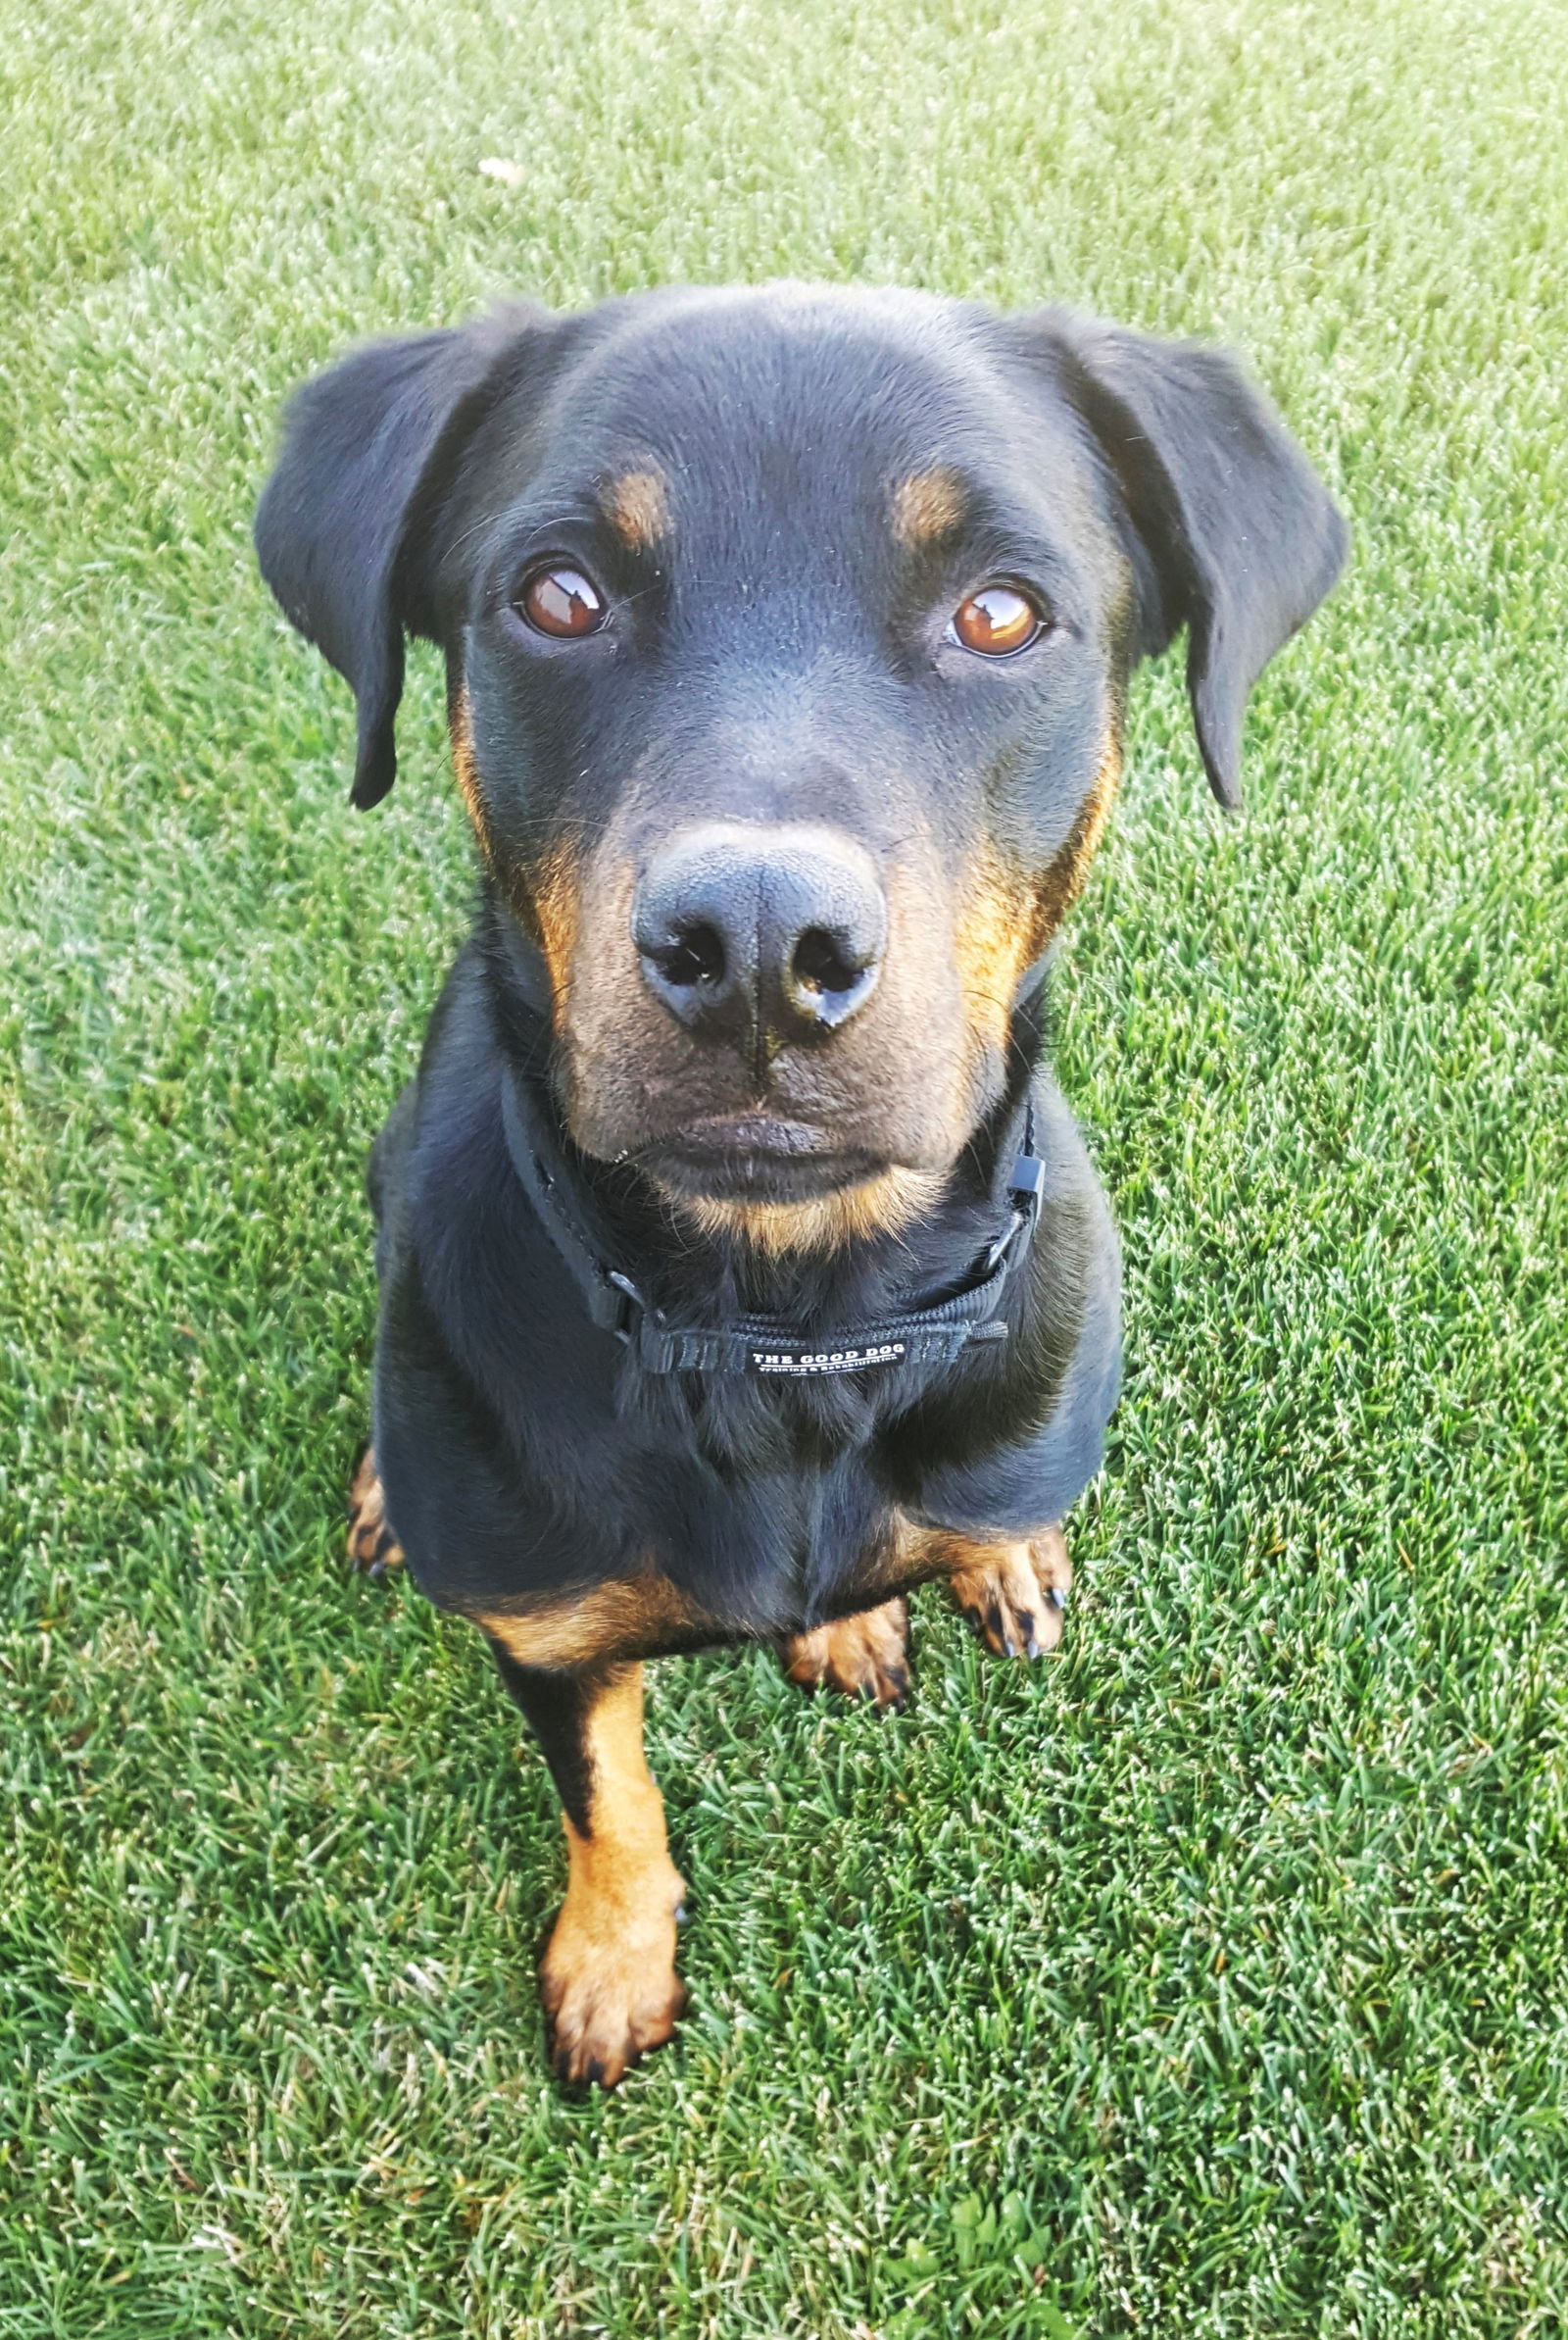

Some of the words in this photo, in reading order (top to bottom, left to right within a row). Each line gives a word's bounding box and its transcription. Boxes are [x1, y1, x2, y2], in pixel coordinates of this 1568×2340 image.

[753, 1353, 793, 1364] THE
[800, 1351, 858, 1364] GOOD
[865, 1343, 905, 1357] DOG
